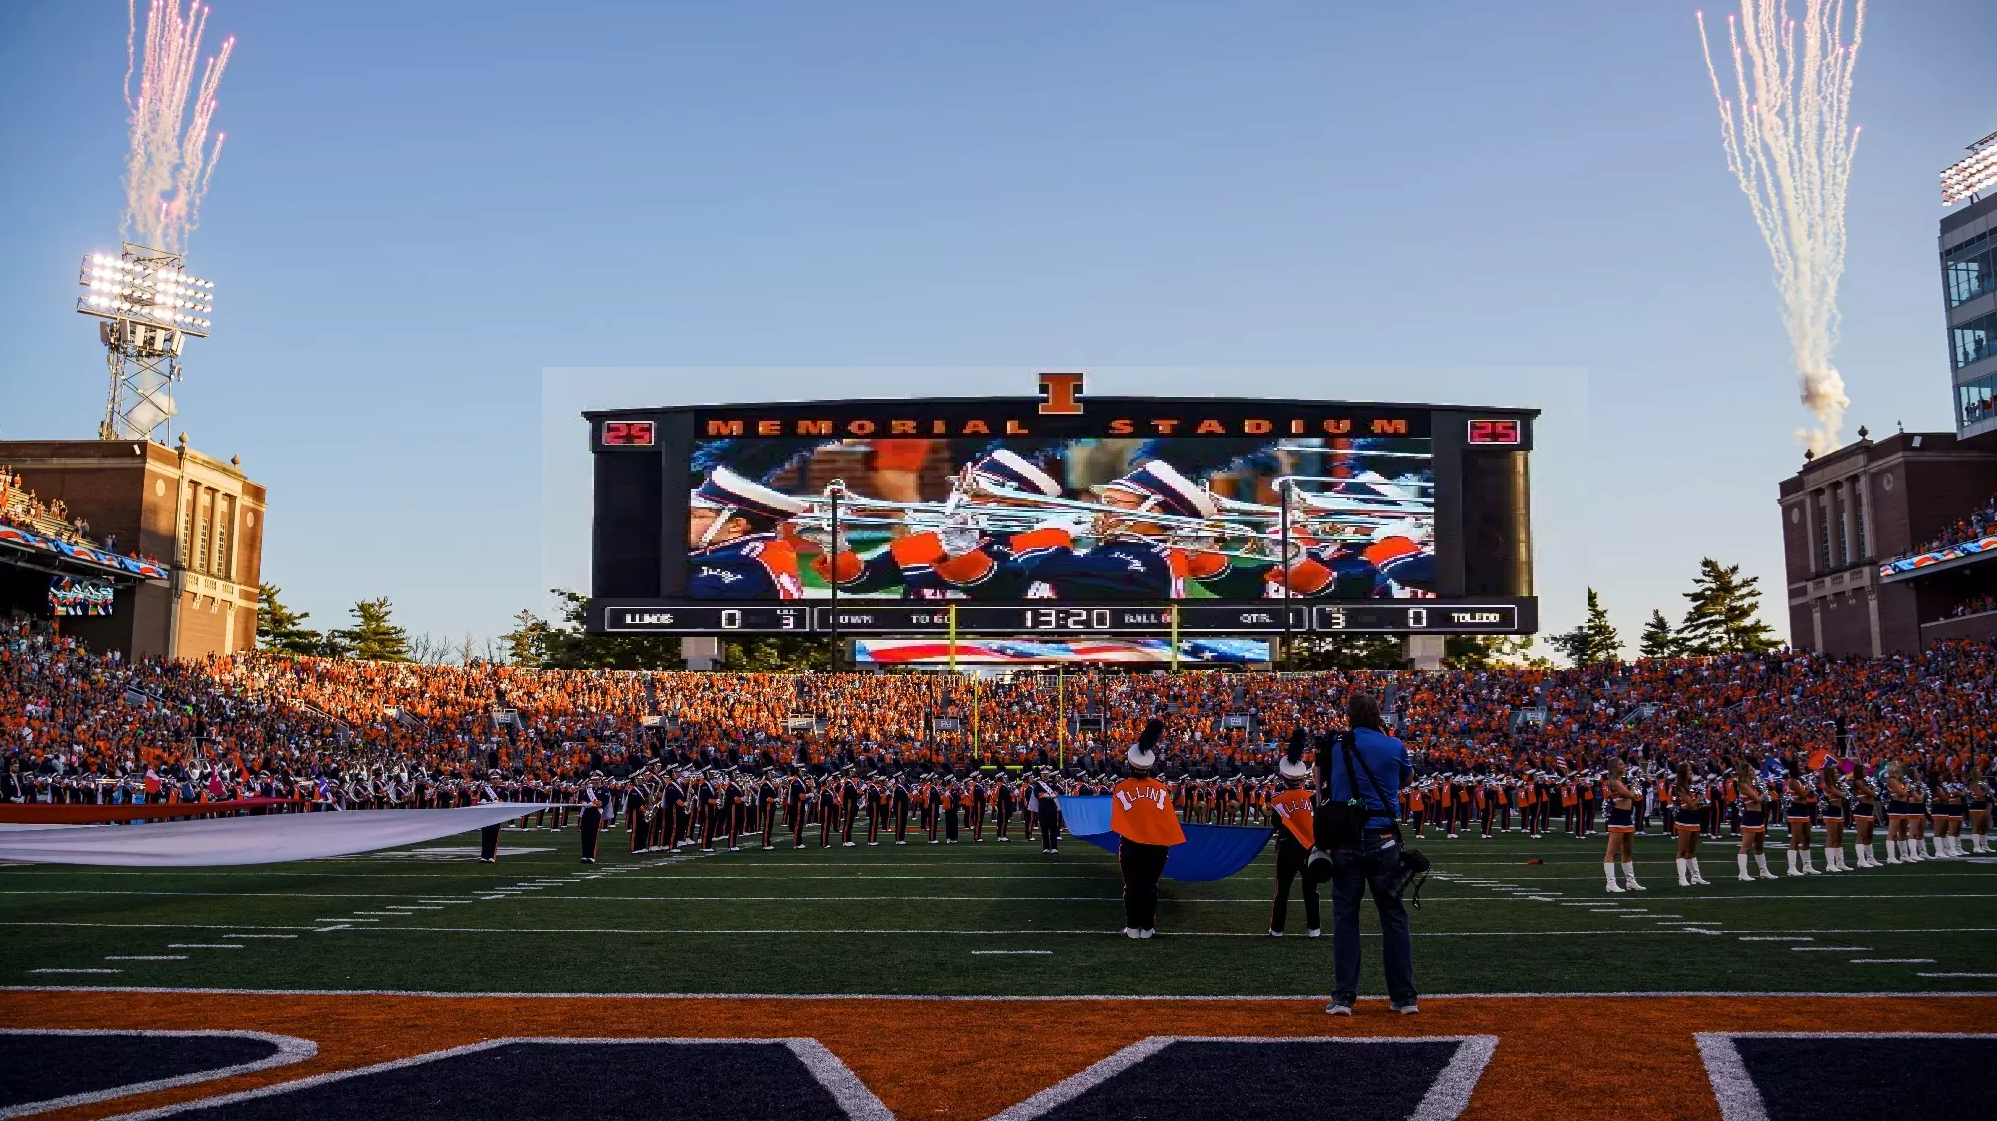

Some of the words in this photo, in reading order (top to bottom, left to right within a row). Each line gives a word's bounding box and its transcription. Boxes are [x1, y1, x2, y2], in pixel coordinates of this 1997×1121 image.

[1038, 372, 1084, 414] I
[604, 423, 653, 444] 25
[707, 420, 1029, 437] MEMORIAL
[1108, 419, 1409, 435] STADIUM
[1470, 421, 1519, 443] 25
[721, 610, 741, 629] 0
[1026, 609, 1110, 629] 13:20
[1408, 608, 1427, 628] 0
[1452, 613, 1500, 623] TOLEDO
[1116, 786, 1167, 811] ILLINI
